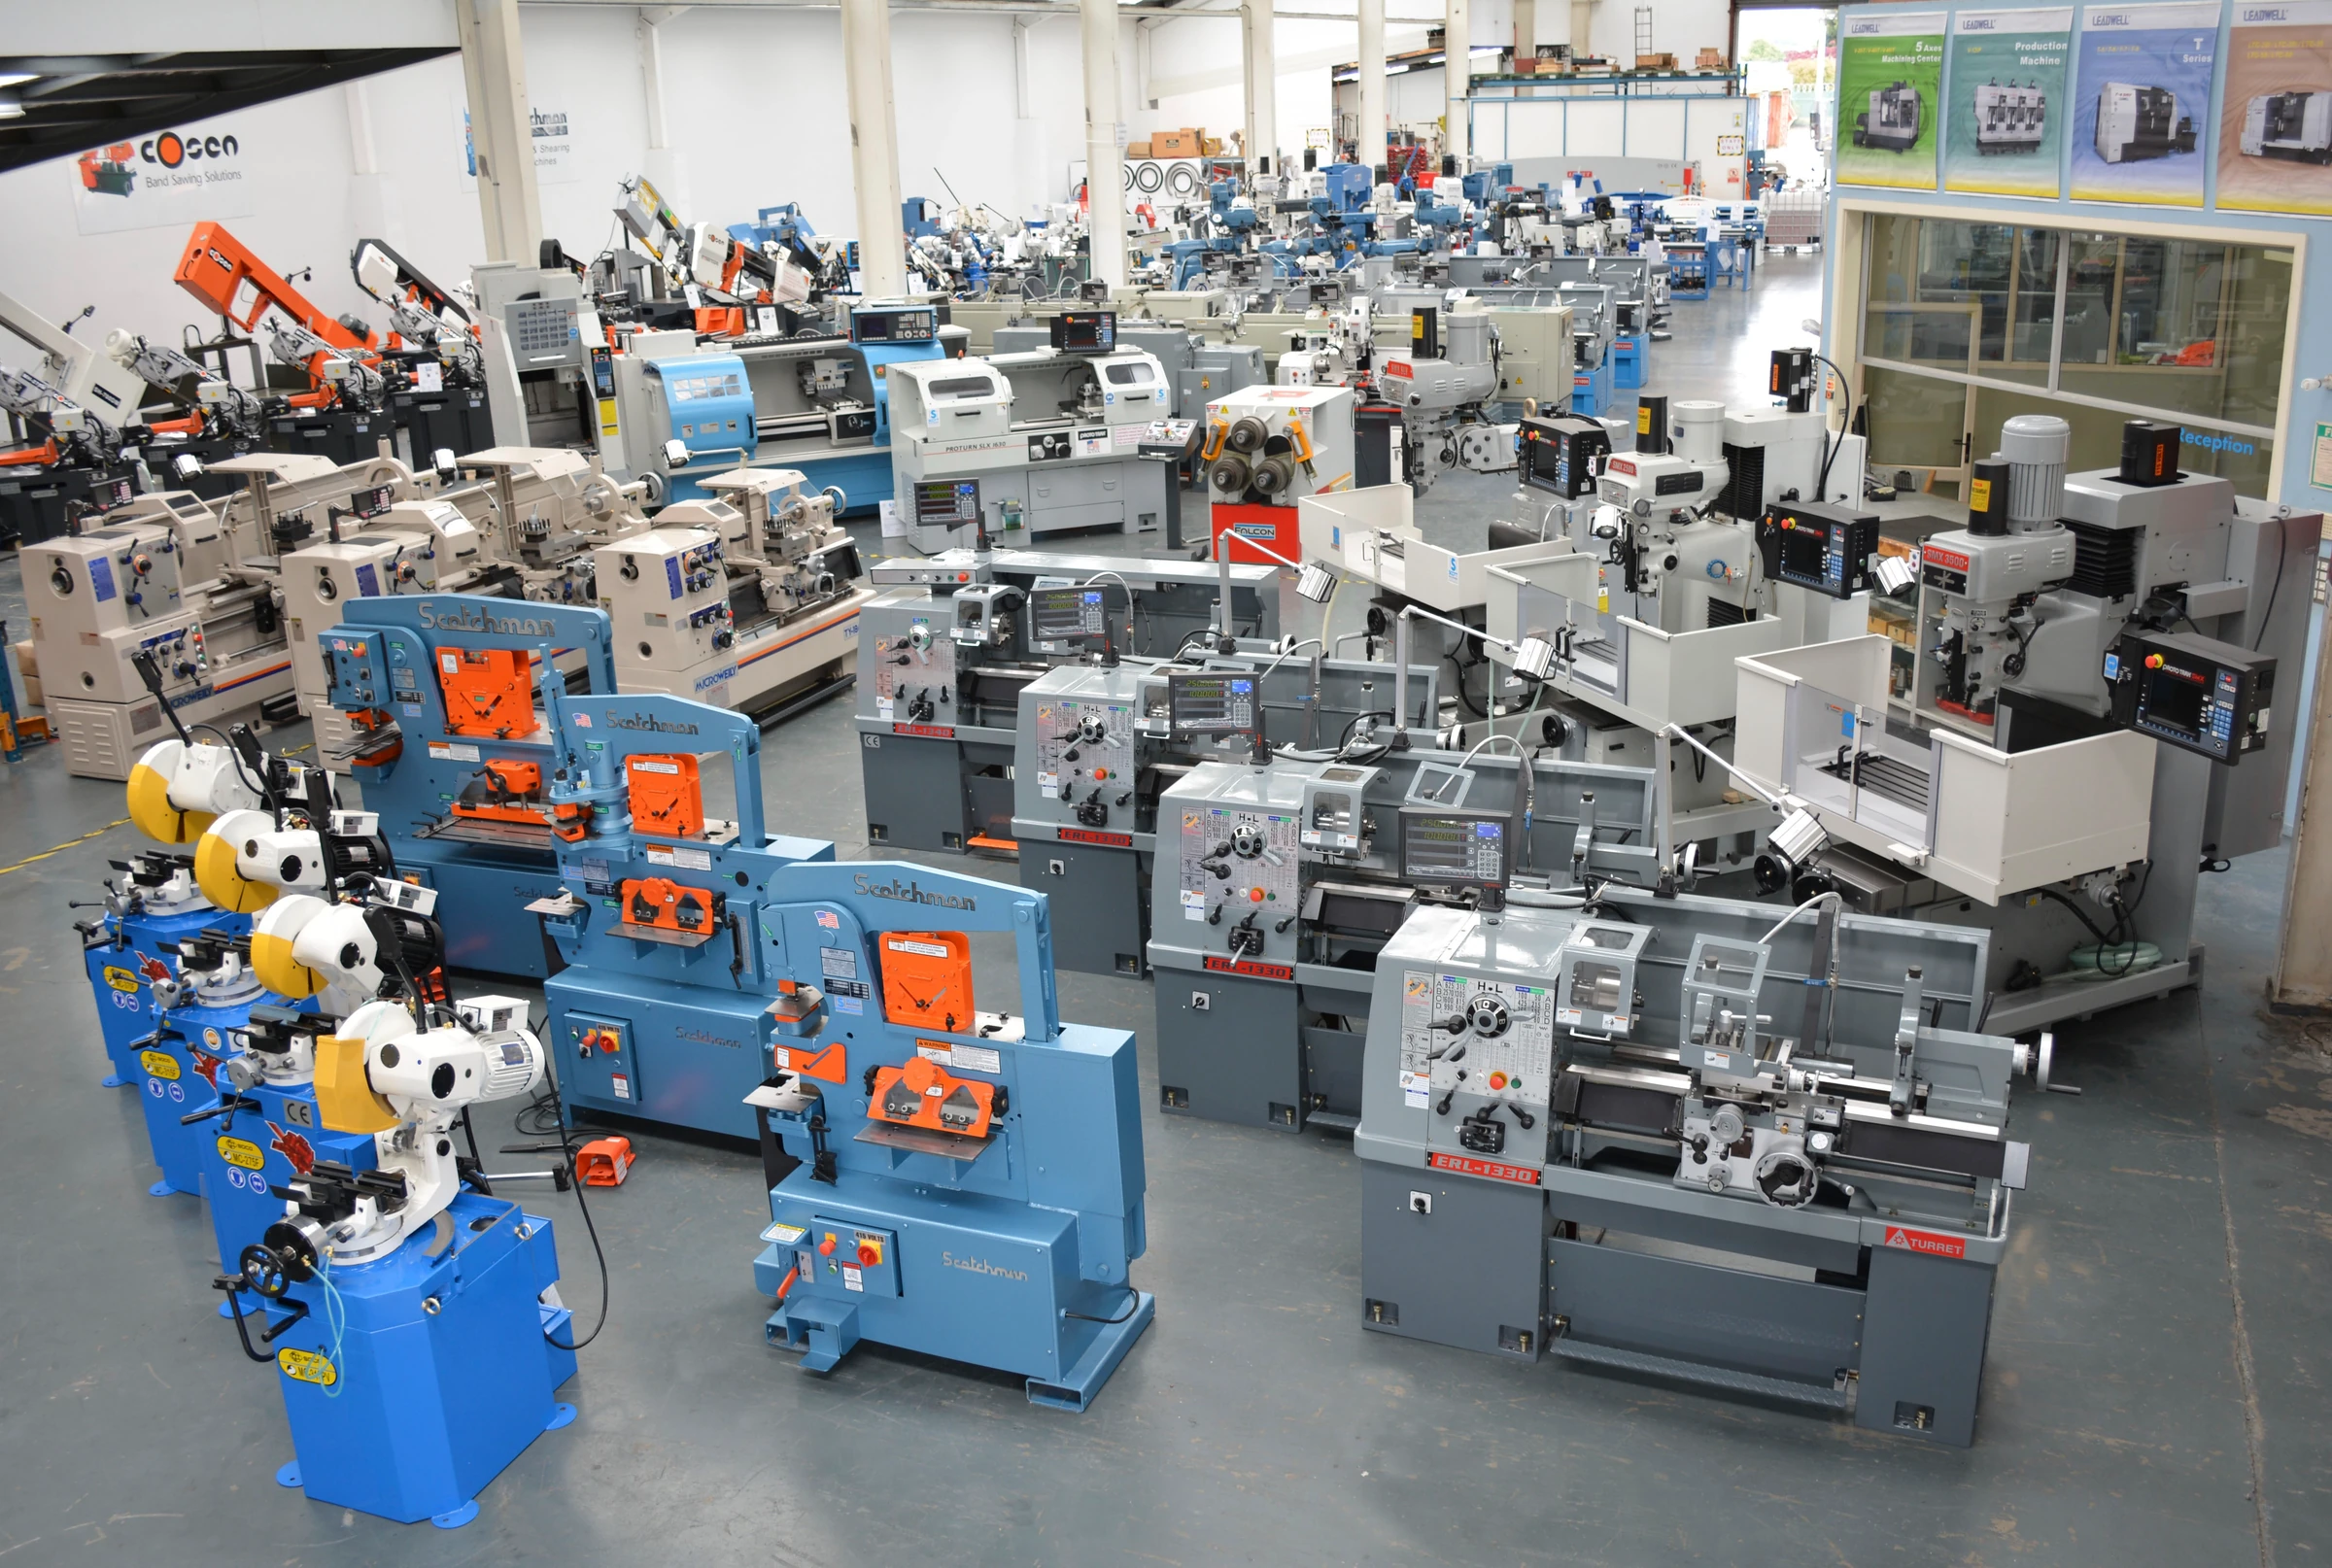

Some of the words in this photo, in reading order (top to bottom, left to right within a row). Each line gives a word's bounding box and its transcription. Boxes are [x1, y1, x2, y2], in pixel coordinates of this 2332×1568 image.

[2092, 16, 2128, 26] LEADWELL
[2244, 10, 2286, 21] LEADWELL
[1851, 24, 1879, 34] LEADWELL
[1963, 19, 1995, 30] LEADWELL
[1916, 41, 1923, 51] 5
[2015, 42, 2068, 51] Production
[2194, 38, 2204, 51] T
[1881, 55, 1916, 64] Machining
[2020, 56, 2061, 66] Machine
[2182, 54, 2212, 63] Series
[530, 107, 567, 125] chman
[540, 144, 569, 153] Shearing
[534, 157, 557, 166] chines
[146, 176, 169, 188] Band
[172, 173, 203, 187] Sawing
[205, 170, 242, 183] Solutions
[946, 444, 977, 453] PROTURN
[1613, 460, 1623, 470] SMX
[1623, 463, 1634, 474] 2500
[1234, 527, 1275, 535] FALCON
[1928, 549, 1943, 562] SMX
[1945, 554, 1965, 567] 3500
[418, 602, 556, 637] Scotchman
[606, 709, 700, 735] Scotchman
[854, 873, 976, 911] Scotchman
[1478, 981, 1486, 991] H
[1495, 983, 1503, 994] L
[676, 1026, 741, 1049] Scotchman
[287, 1103, 310, 1125] CE
[1436, 1155, 1531, 1181] ERL-1330
[868, 1234, 884, 1243] VOLTS
[1910, 1238, 1962, 1255] TURRET
[942, 1251, 1028, 1281] Scotchman
